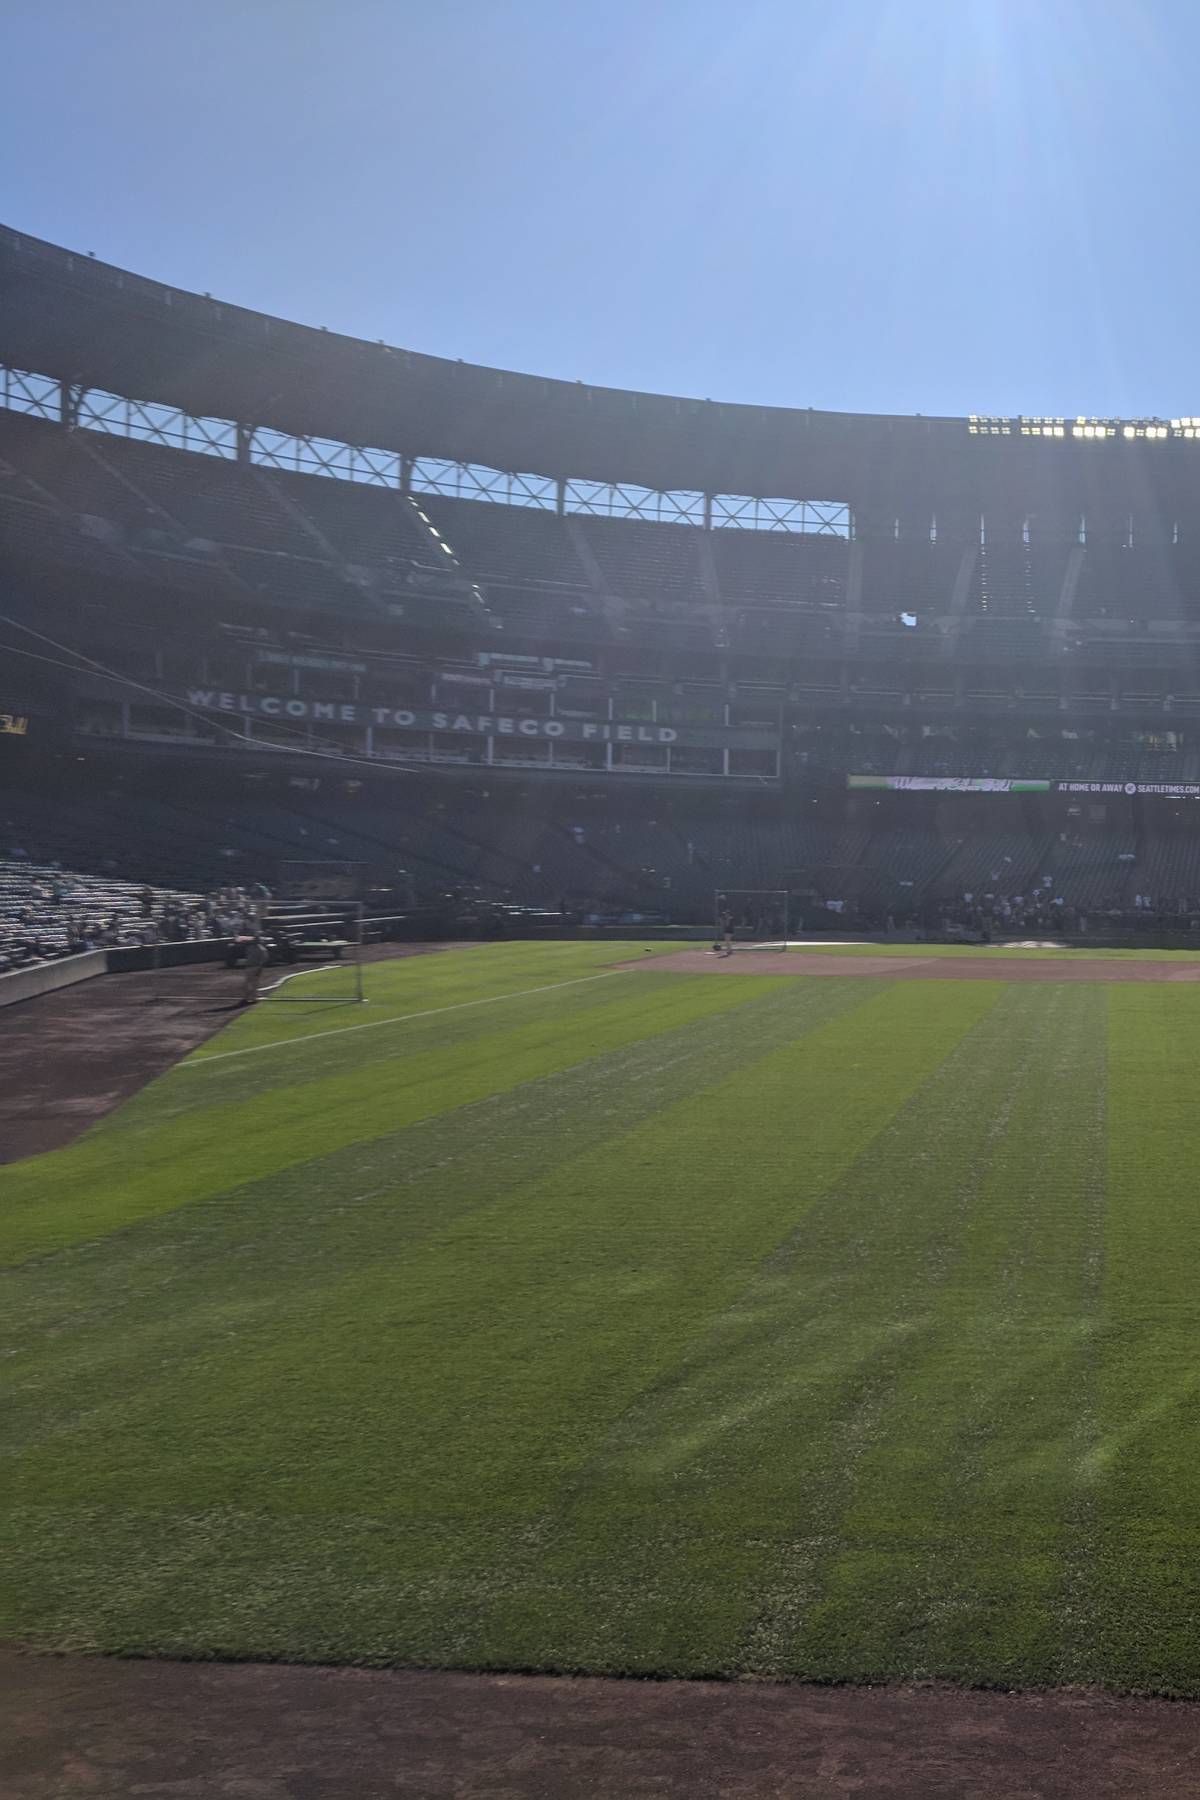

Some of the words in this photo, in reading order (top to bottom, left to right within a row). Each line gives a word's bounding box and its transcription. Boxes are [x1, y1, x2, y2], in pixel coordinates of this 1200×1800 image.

[188, 690, 356, 721] WELCOME
[372, 707, 416, 725] TO
[432, 712, 565, 737] SAFECO
[583, 723, 678, 742] FIELD
[1058, 783, 1067, 791] AT
[1069, 783, 1089, 792] HOME
[1090, 783, 1100, 792] OR
[1102, 784, 1123, 792] AWAY
[1137, 784, 1200, 794] SEATTLETIMES.COM
